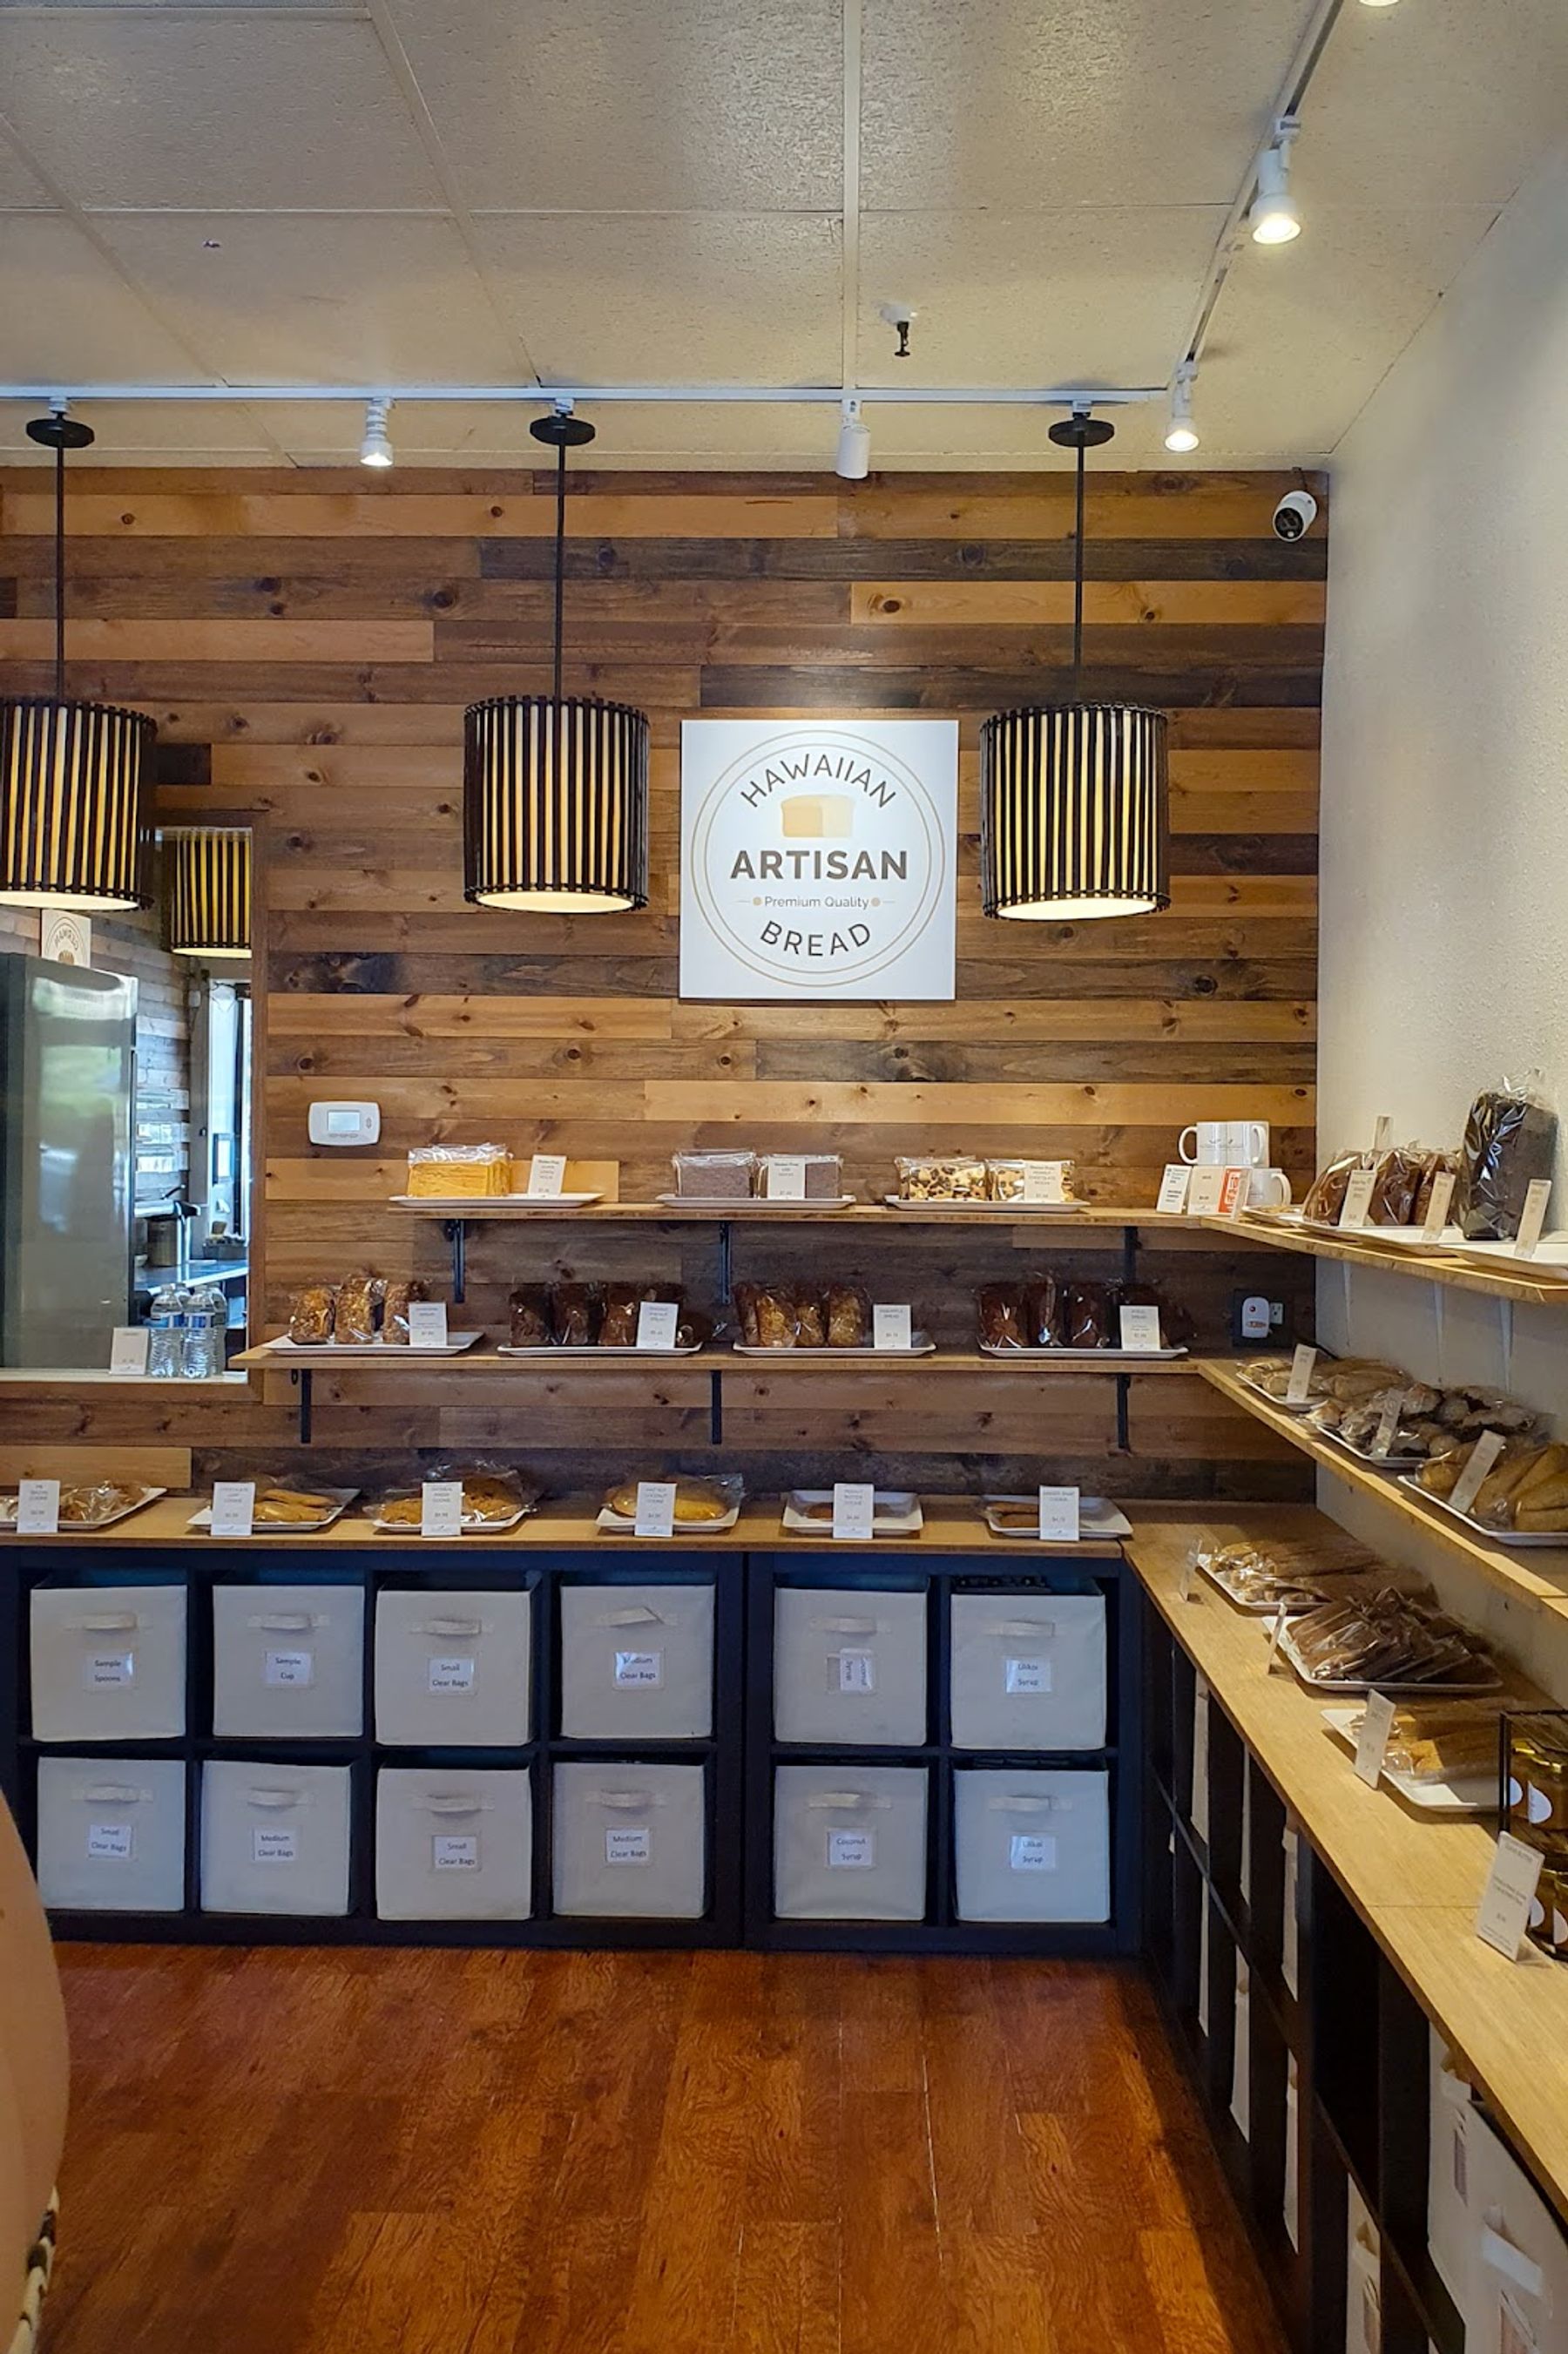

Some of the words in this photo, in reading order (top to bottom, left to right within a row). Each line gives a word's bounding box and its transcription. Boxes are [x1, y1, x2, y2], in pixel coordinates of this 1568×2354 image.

[740, 754, 896, 808] HAWAIIAN
[730, 850, 908, 880] ARTISAN
[764, 896, 821, 908] Premium
[824, 896, 869, 910] Quality
[760, 920, 871, 957] BREAD
[280, 1672, 294, 1681] Cup
